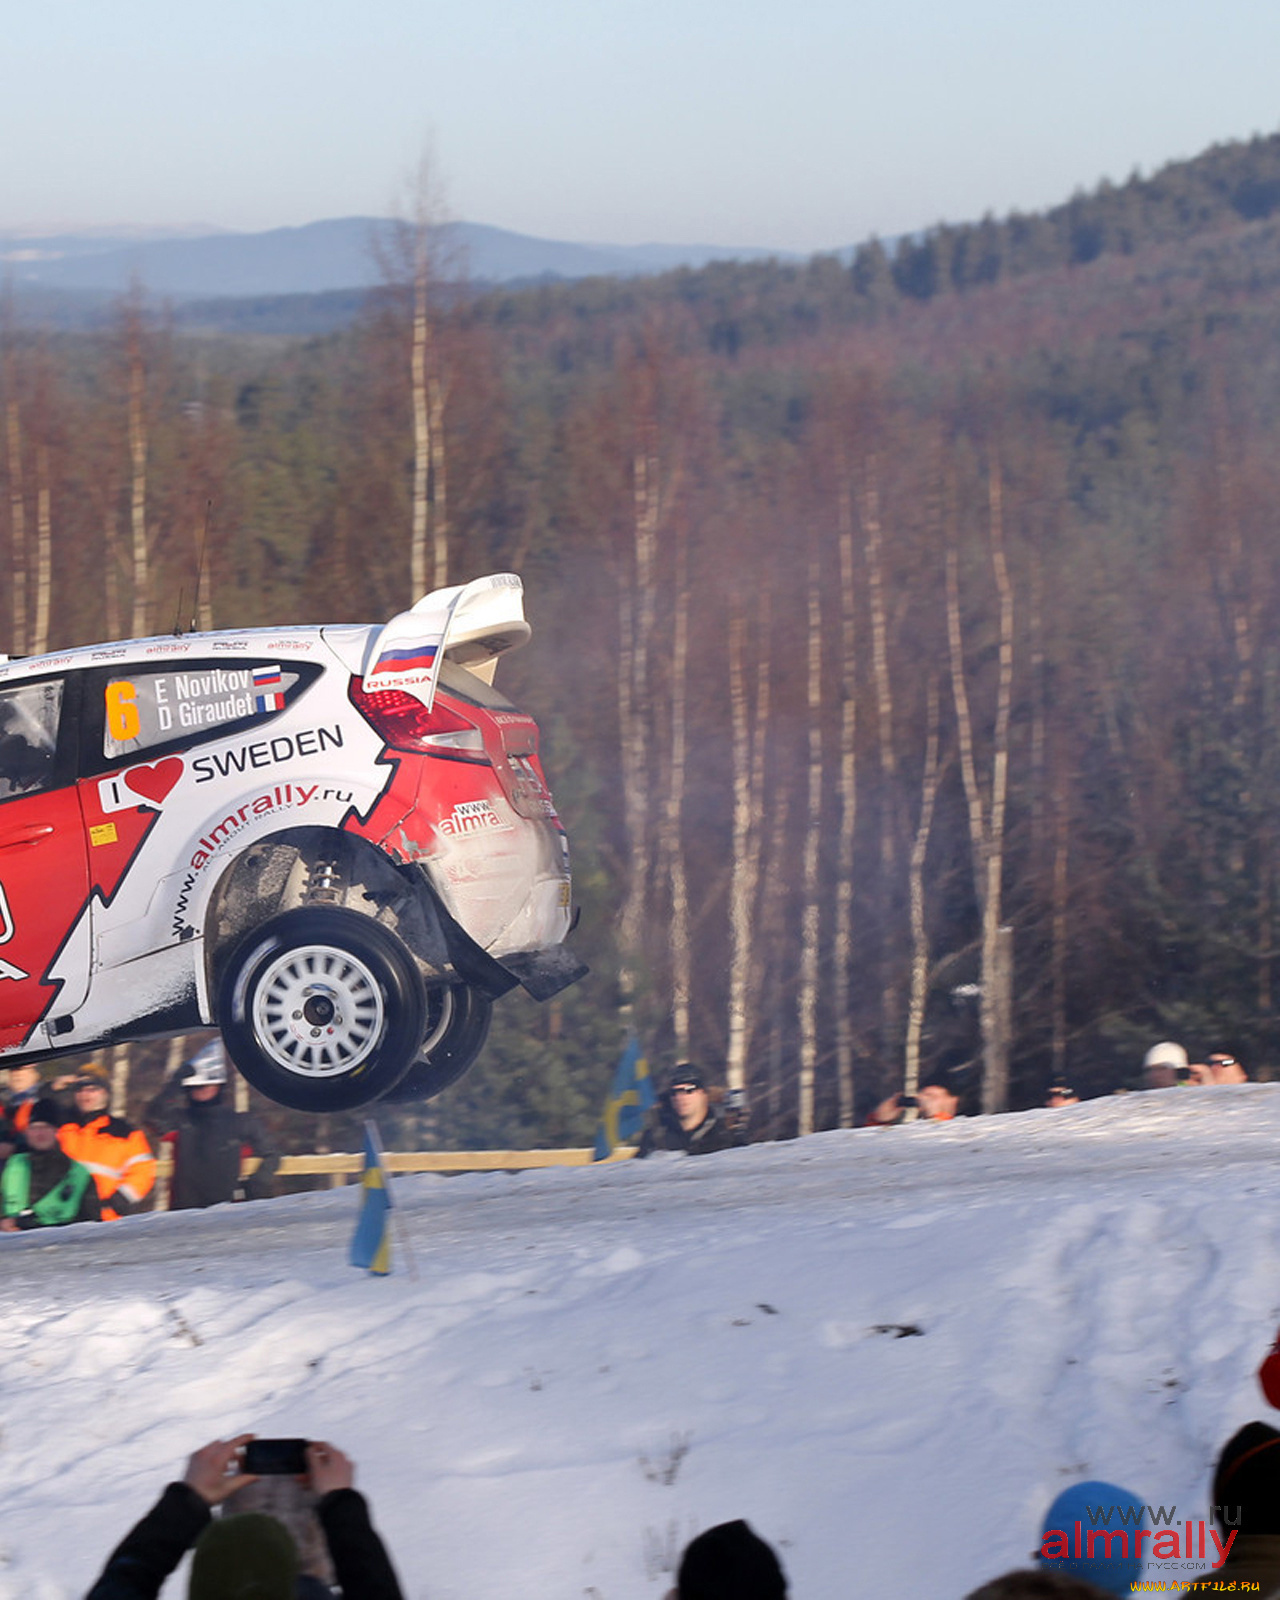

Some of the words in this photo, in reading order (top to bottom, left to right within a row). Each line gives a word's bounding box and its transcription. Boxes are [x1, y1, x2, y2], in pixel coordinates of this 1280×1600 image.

[154, 679, 168, 704] E
[175, 669, 249, 700] Novikov
[366, 675, 432, 689] RUSSIA
[104, 681, 141, 741] 6
[159, 706, 172, 731] D
[179, 692, 255, 727] Giraudet
[111, 782, 120, 804] I
[192, 725, 344, 783] SWEDEN
